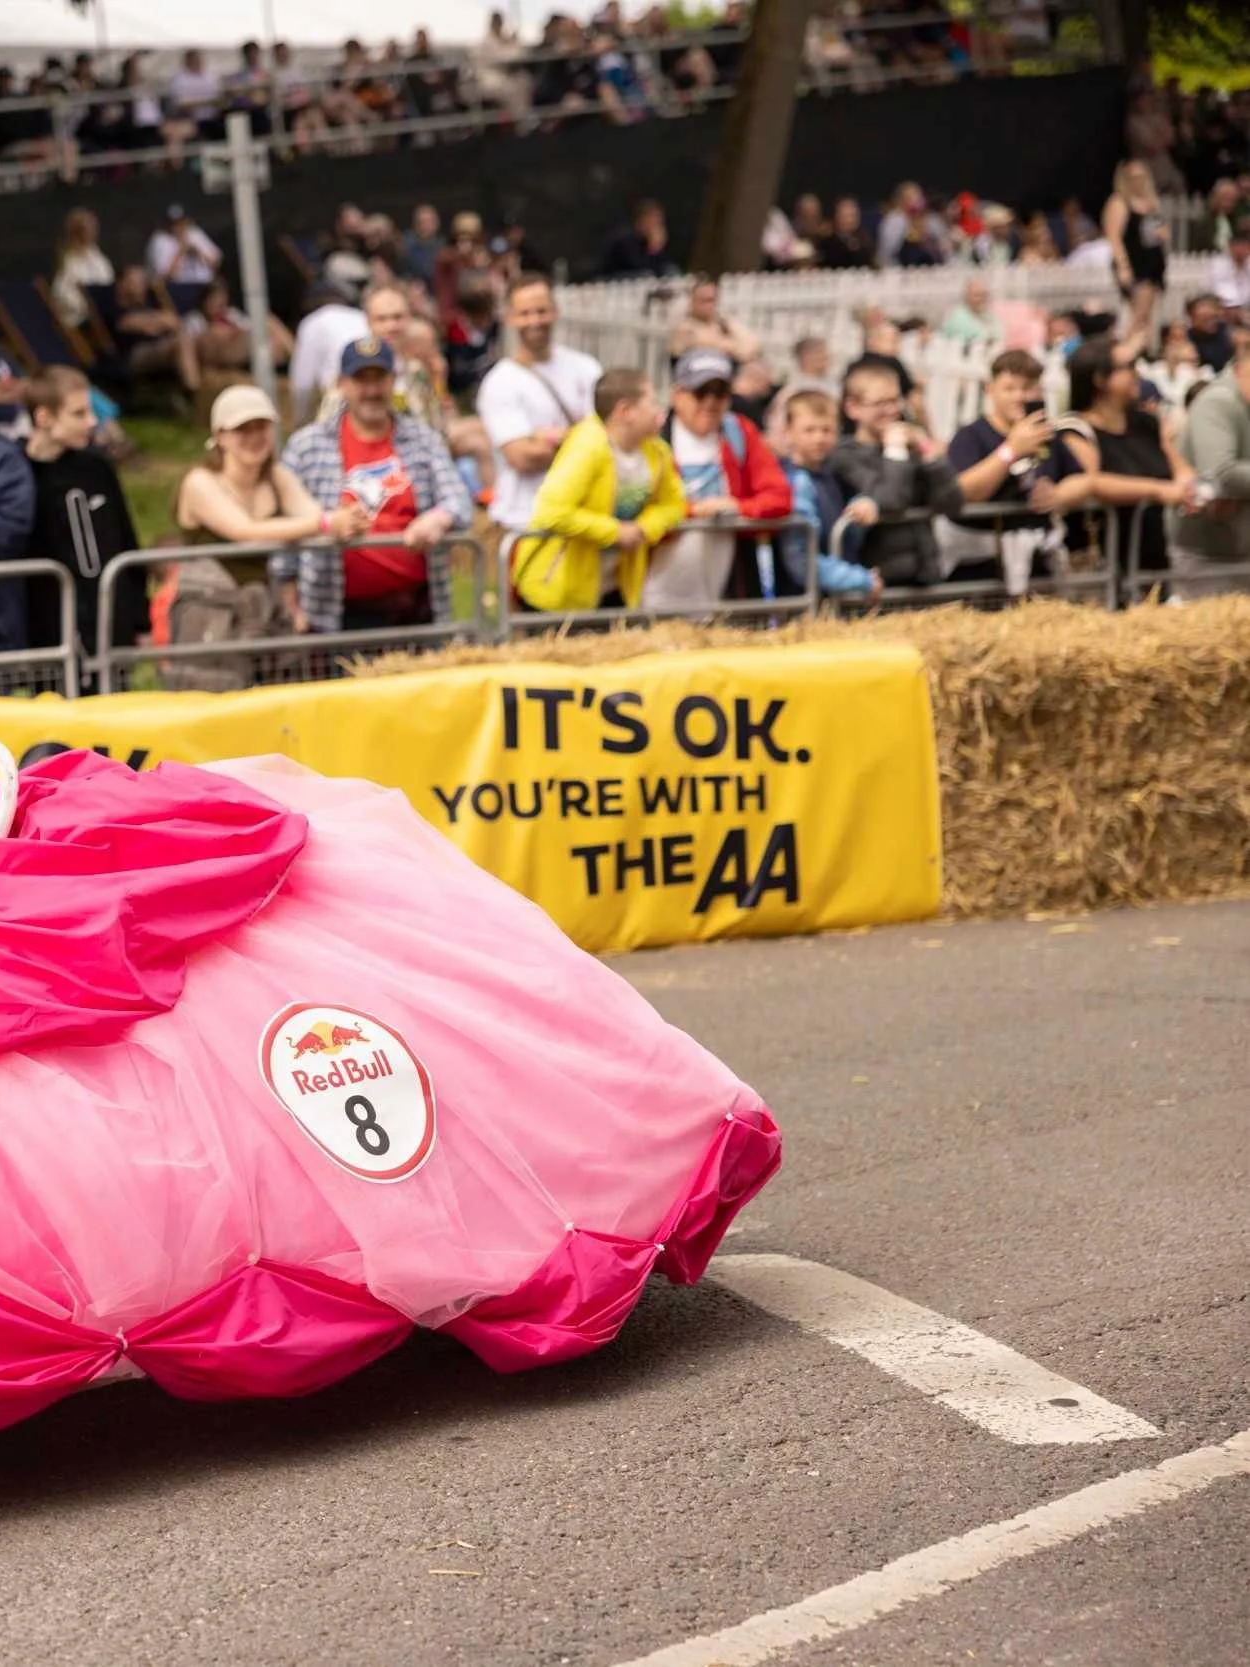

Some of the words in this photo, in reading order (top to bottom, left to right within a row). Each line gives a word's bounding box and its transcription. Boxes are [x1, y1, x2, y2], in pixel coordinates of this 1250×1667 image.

[501, 686, 650, 755] IT'S
[673, 695, 813, 764] OK.
[432, 777, 626, 824] YOU'RE
[638, 774, 768, 815] WITH
[571, 834, 697, 897] THE
[692, 822, 801, 914] AA
[291, 1060, 347, 1095] Red
[341, 1049, 393, 1084] Bull
[344, 1094, 390, 1156] 8
